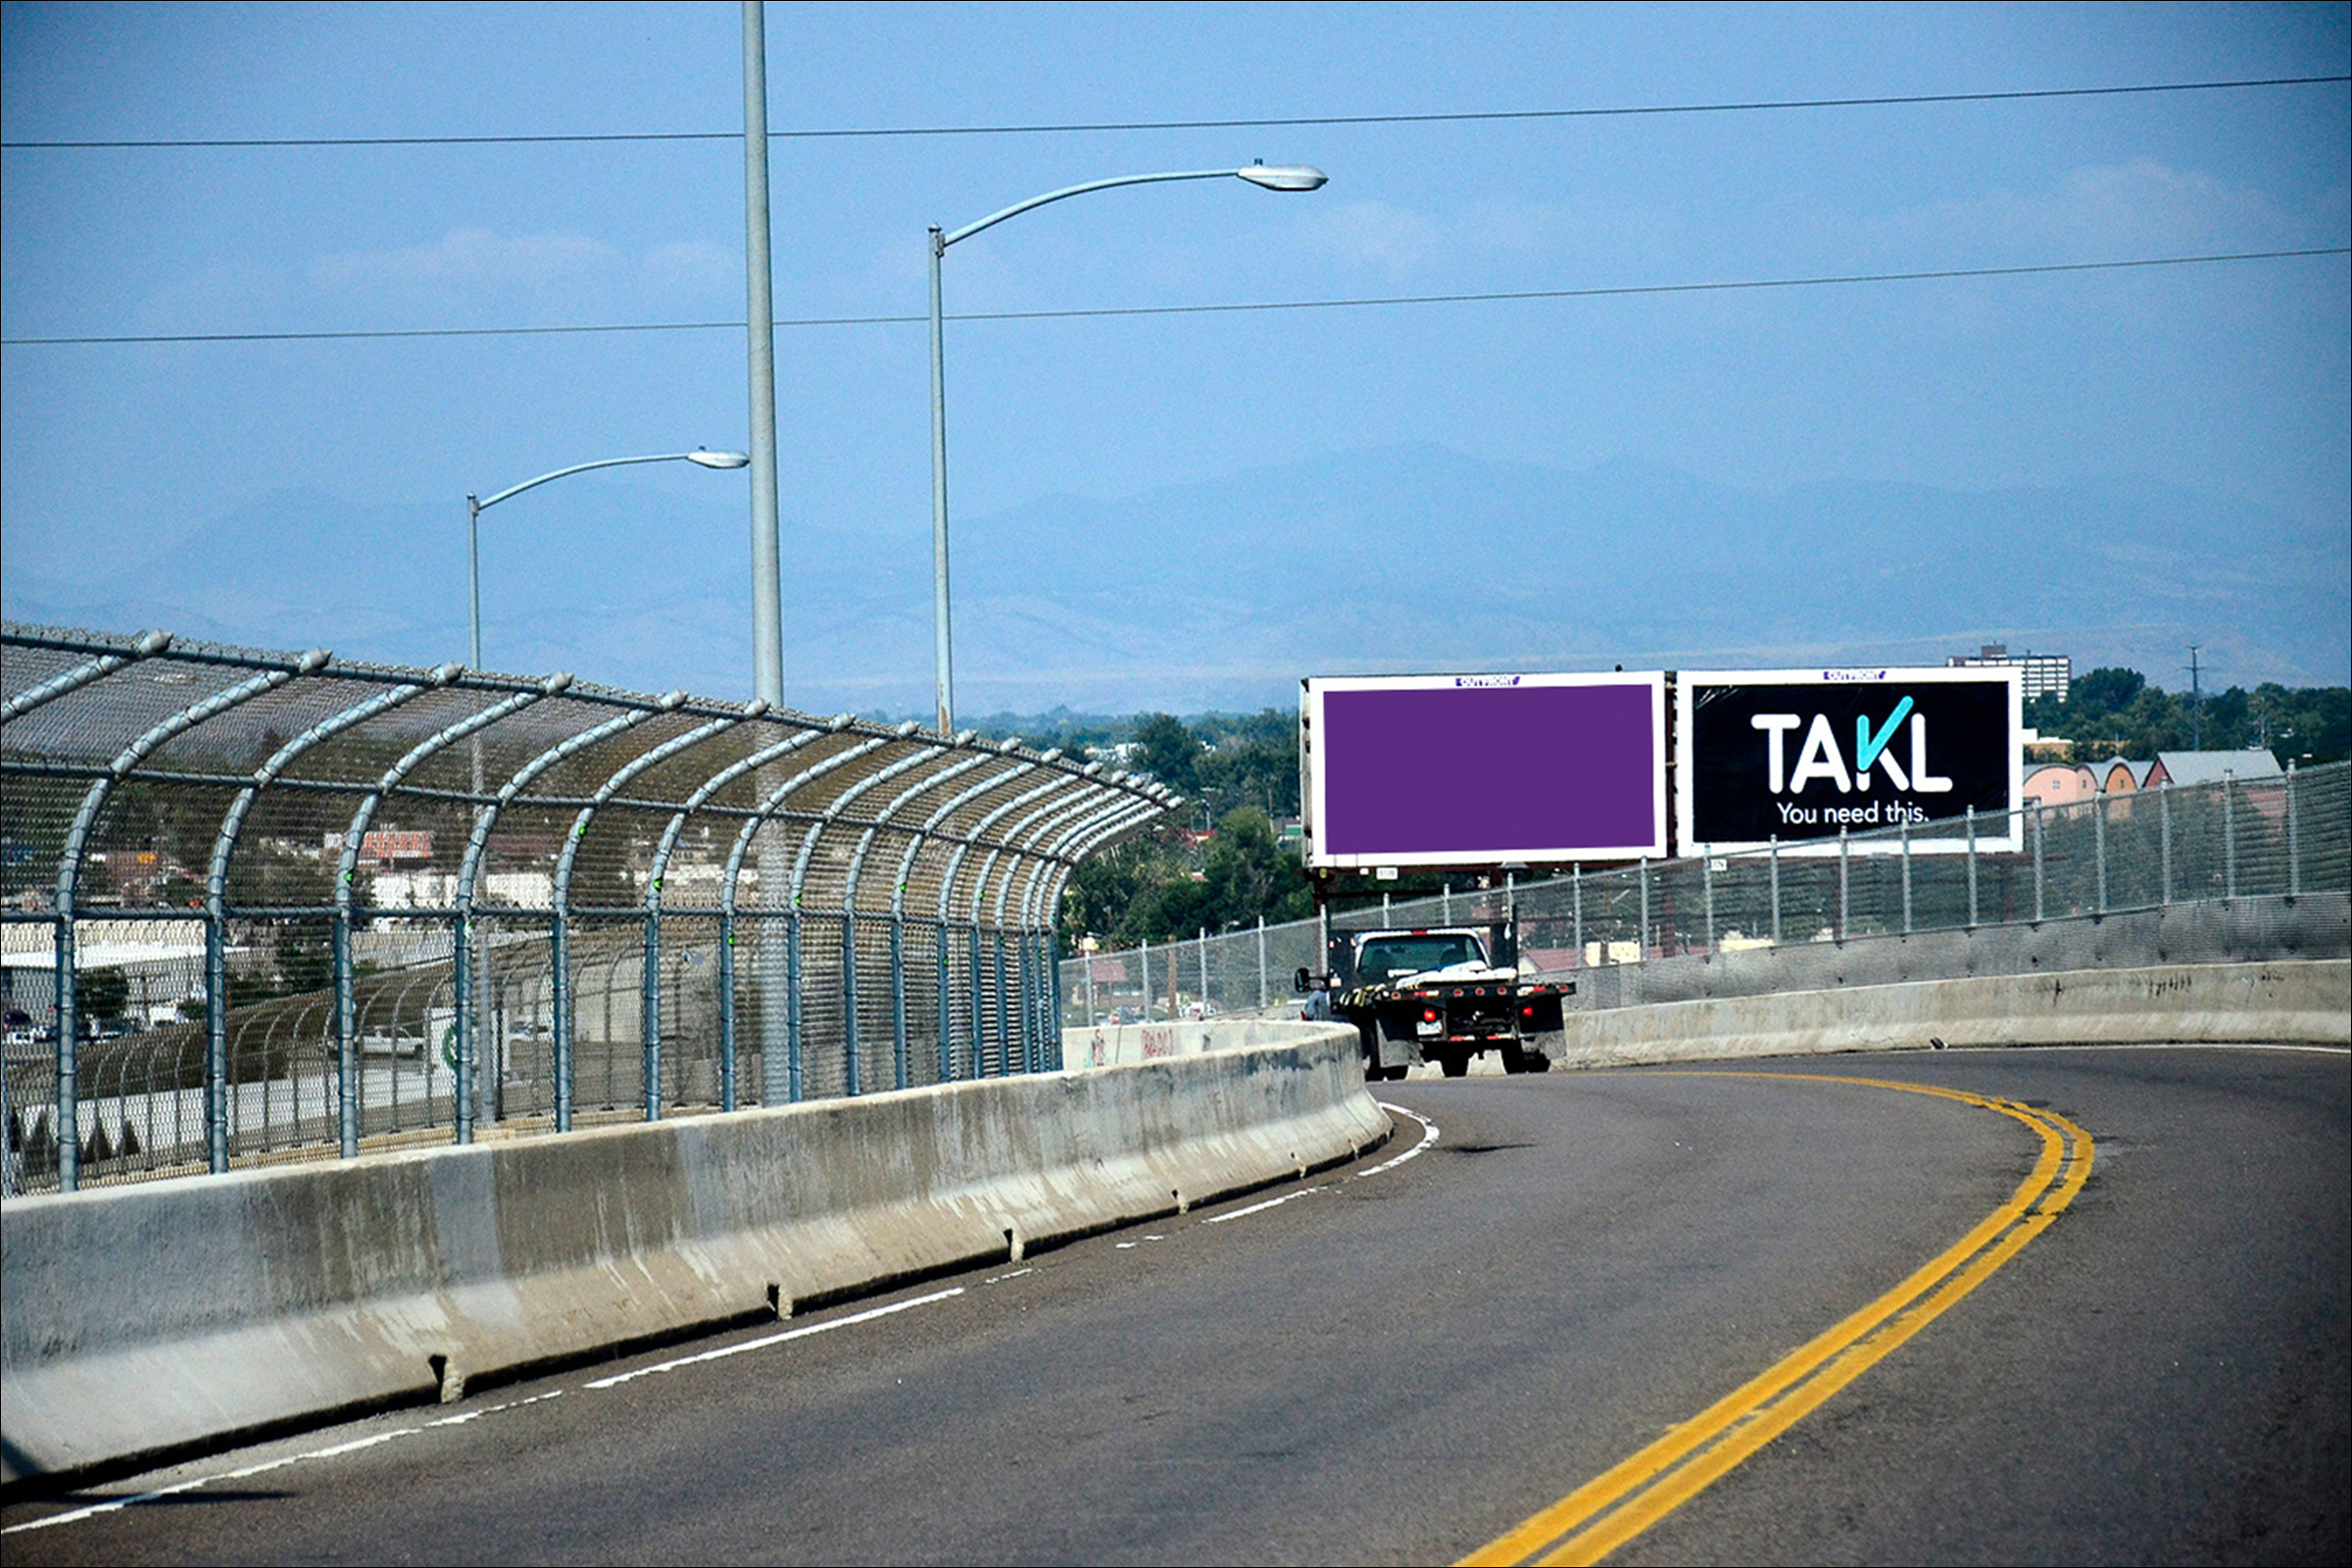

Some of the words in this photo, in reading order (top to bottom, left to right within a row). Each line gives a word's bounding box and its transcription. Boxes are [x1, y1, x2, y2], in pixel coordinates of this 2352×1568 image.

[1750, 695, 1953, 794] TAKL
[1777, 802, 1818, 824] You
[1824, 800, 1879, 823] need
[1885, 800, 1930, 823] this.
